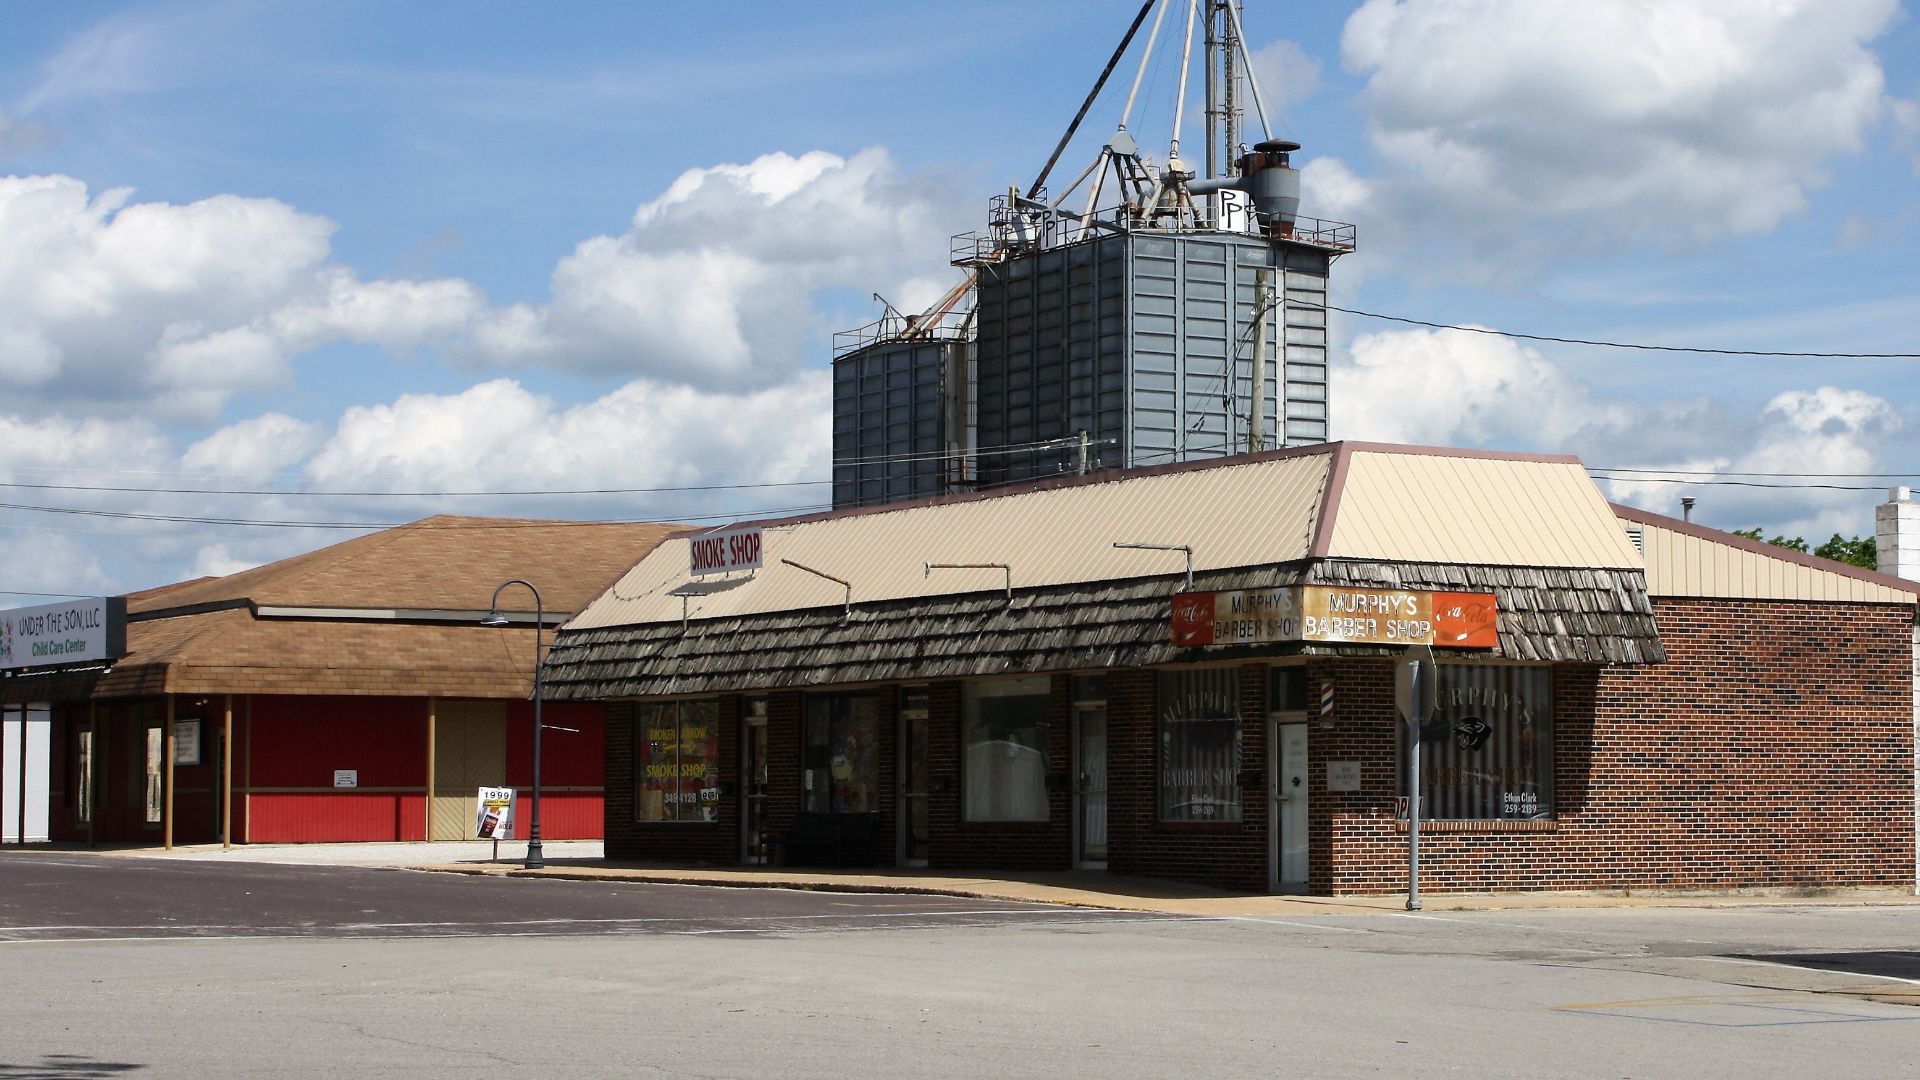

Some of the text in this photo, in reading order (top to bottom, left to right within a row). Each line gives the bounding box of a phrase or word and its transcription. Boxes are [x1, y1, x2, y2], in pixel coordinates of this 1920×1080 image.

[692, 532, 760, 571] SMOKE SHOP
[1328, 592, 1418, 616] MURPHY'S
[19, 616, 45, 637] UNDER
[46, 612, 63, 633] THE
[1214, 618, 1263, 640] BARBER
[1305, 616, 1431, 640] BARBER SHOP
[32, 638, 86, 657] Child Care Center
[646, 763, 707, 778] SMOKE SHOP
[1503, 791, 1538, 803] Ethan Clark
[1504, 803, 1538, 814] 259-2139
